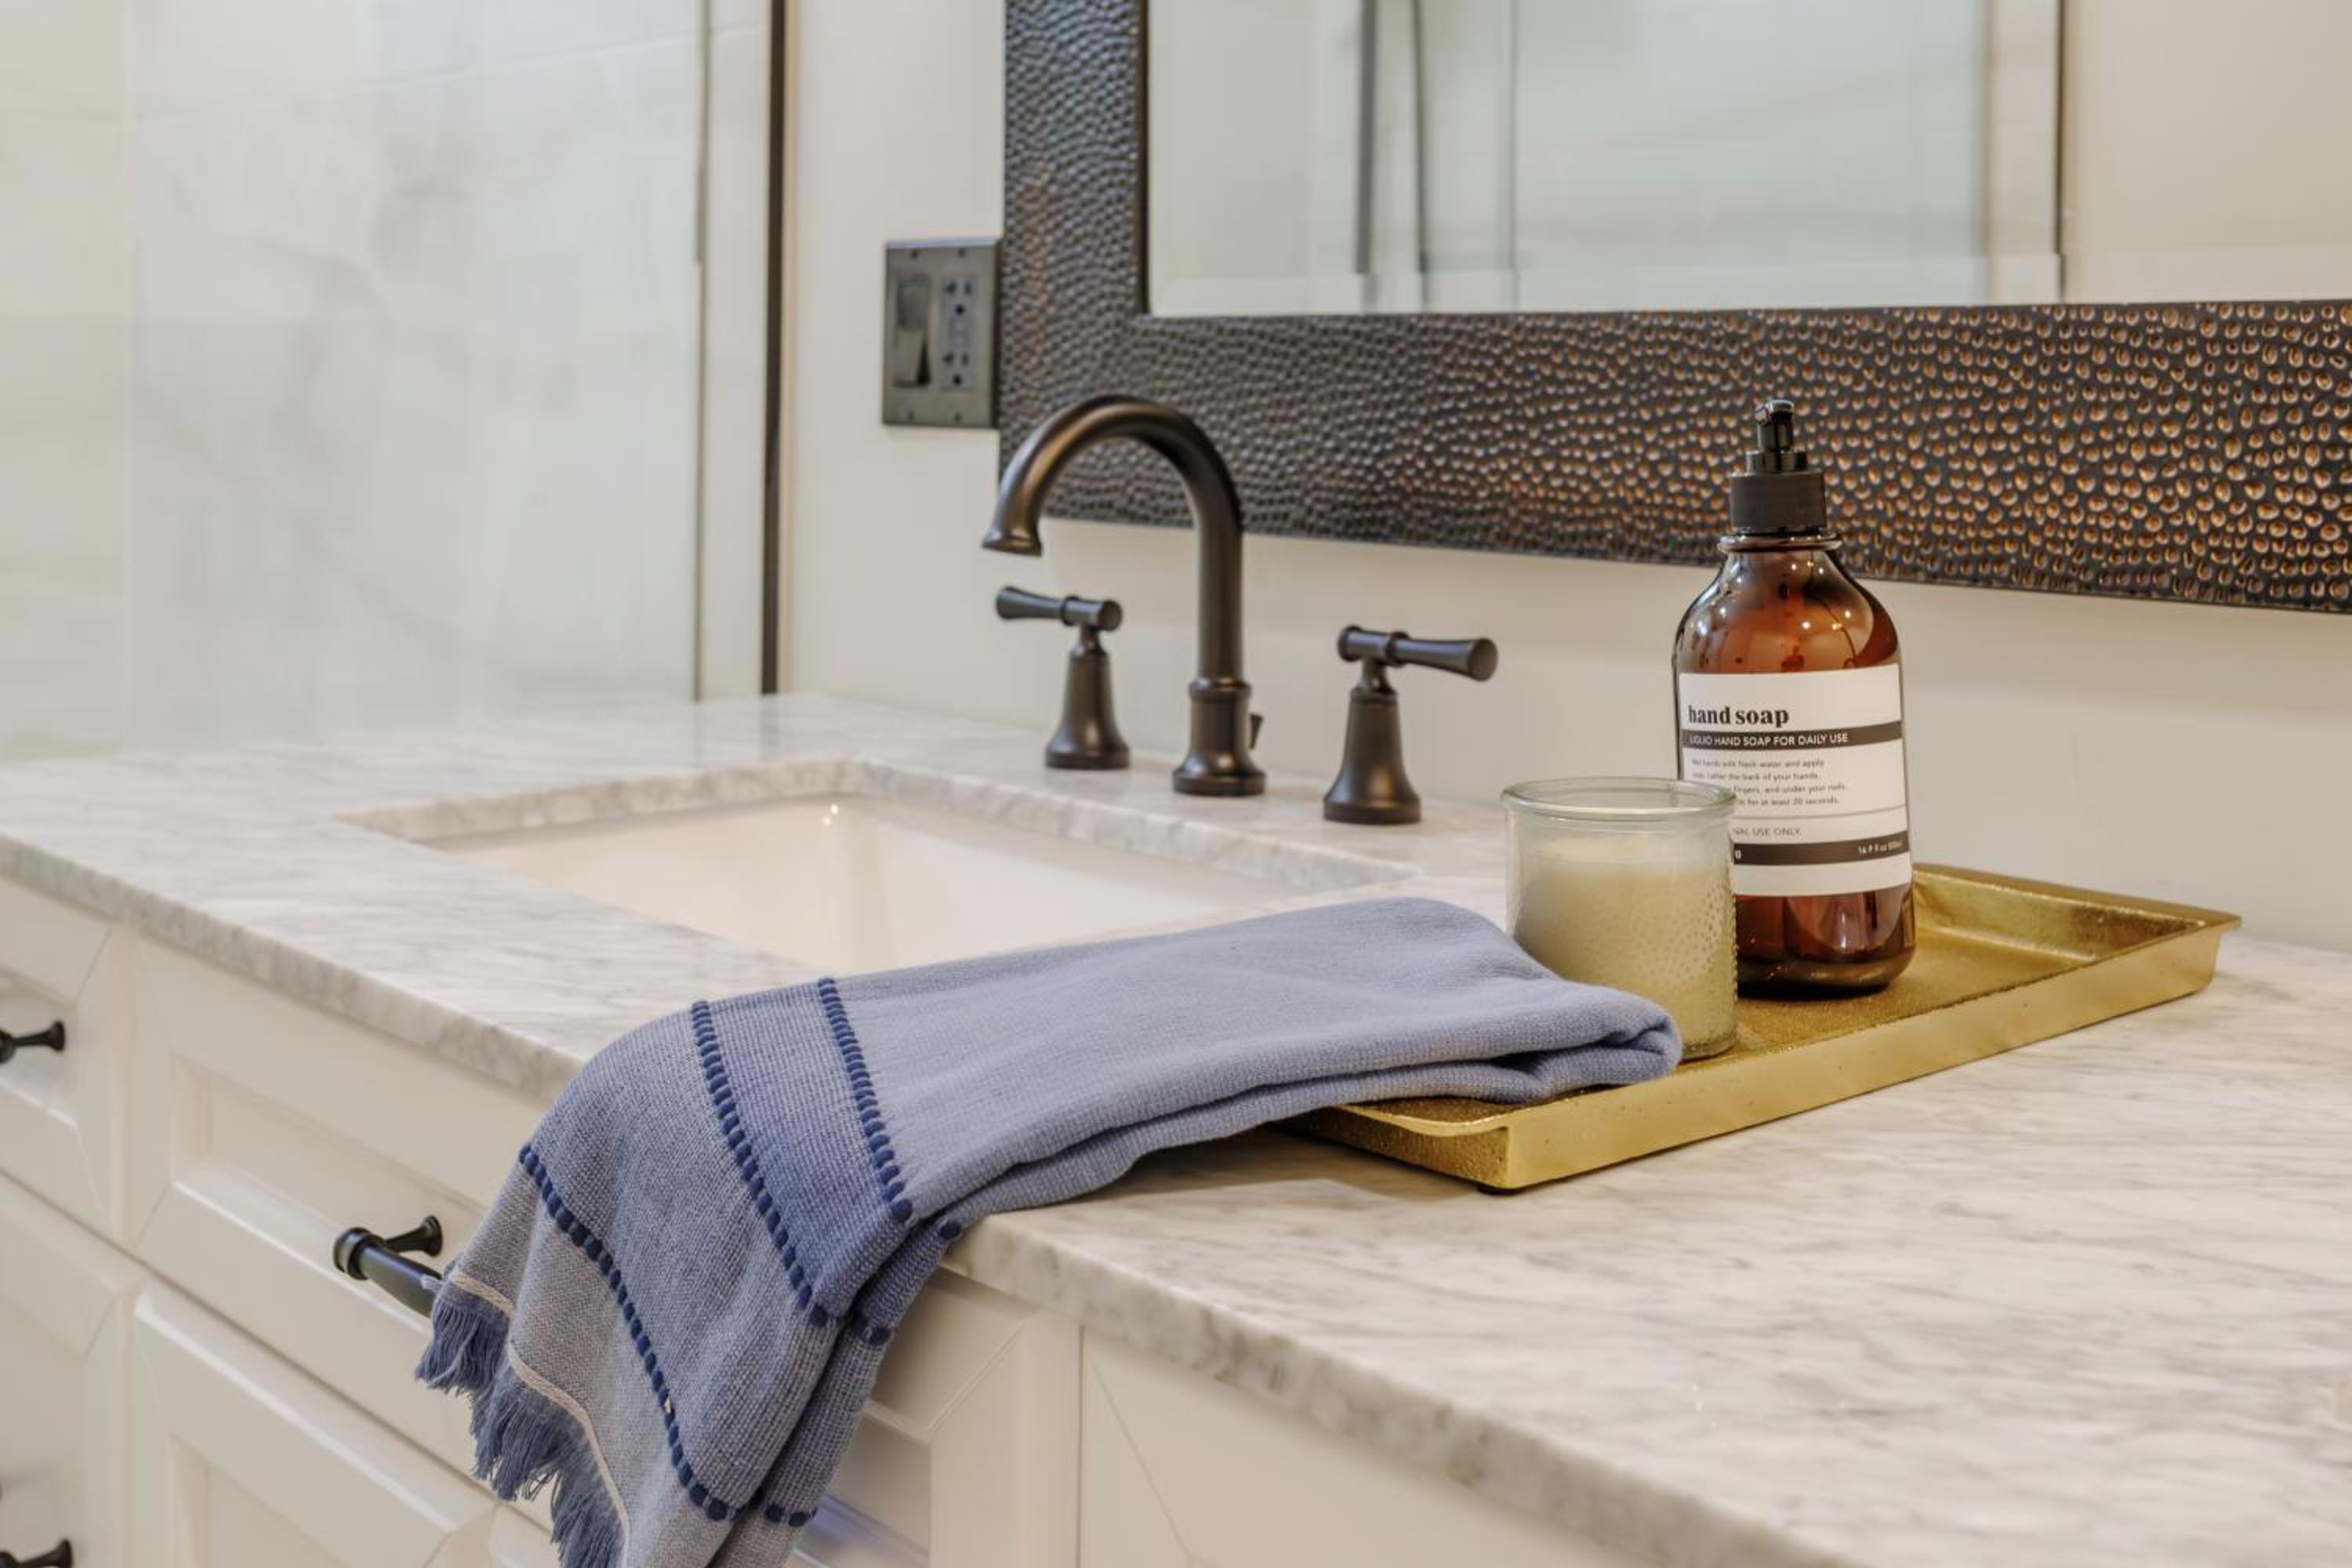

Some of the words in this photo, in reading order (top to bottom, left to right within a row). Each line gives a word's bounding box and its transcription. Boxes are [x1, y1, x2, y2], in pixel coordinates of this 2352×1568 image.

[1689, 705, 1730, 724] hand
[1735, 709, 1790, 728] soap
[1715, 736, 1741, 746] HAND
[1743, 736, 1771, 746] SOAP
[1773, 735, 1795, 746] FOR
[1798, 734, 1828, 746] DAILY
[1828, 733, 1849, 744] USE
[1785, 759, 1801, 768] and
[1802, 757, 1824, 770] apply
[1762, 772, 1771, 781] of
[1773, 773, 1791, 782] your
[1782, 784, 1806, 793] under
[1808, 784, 1827, 795] your
[1792, 796, 1804, 806] 20
